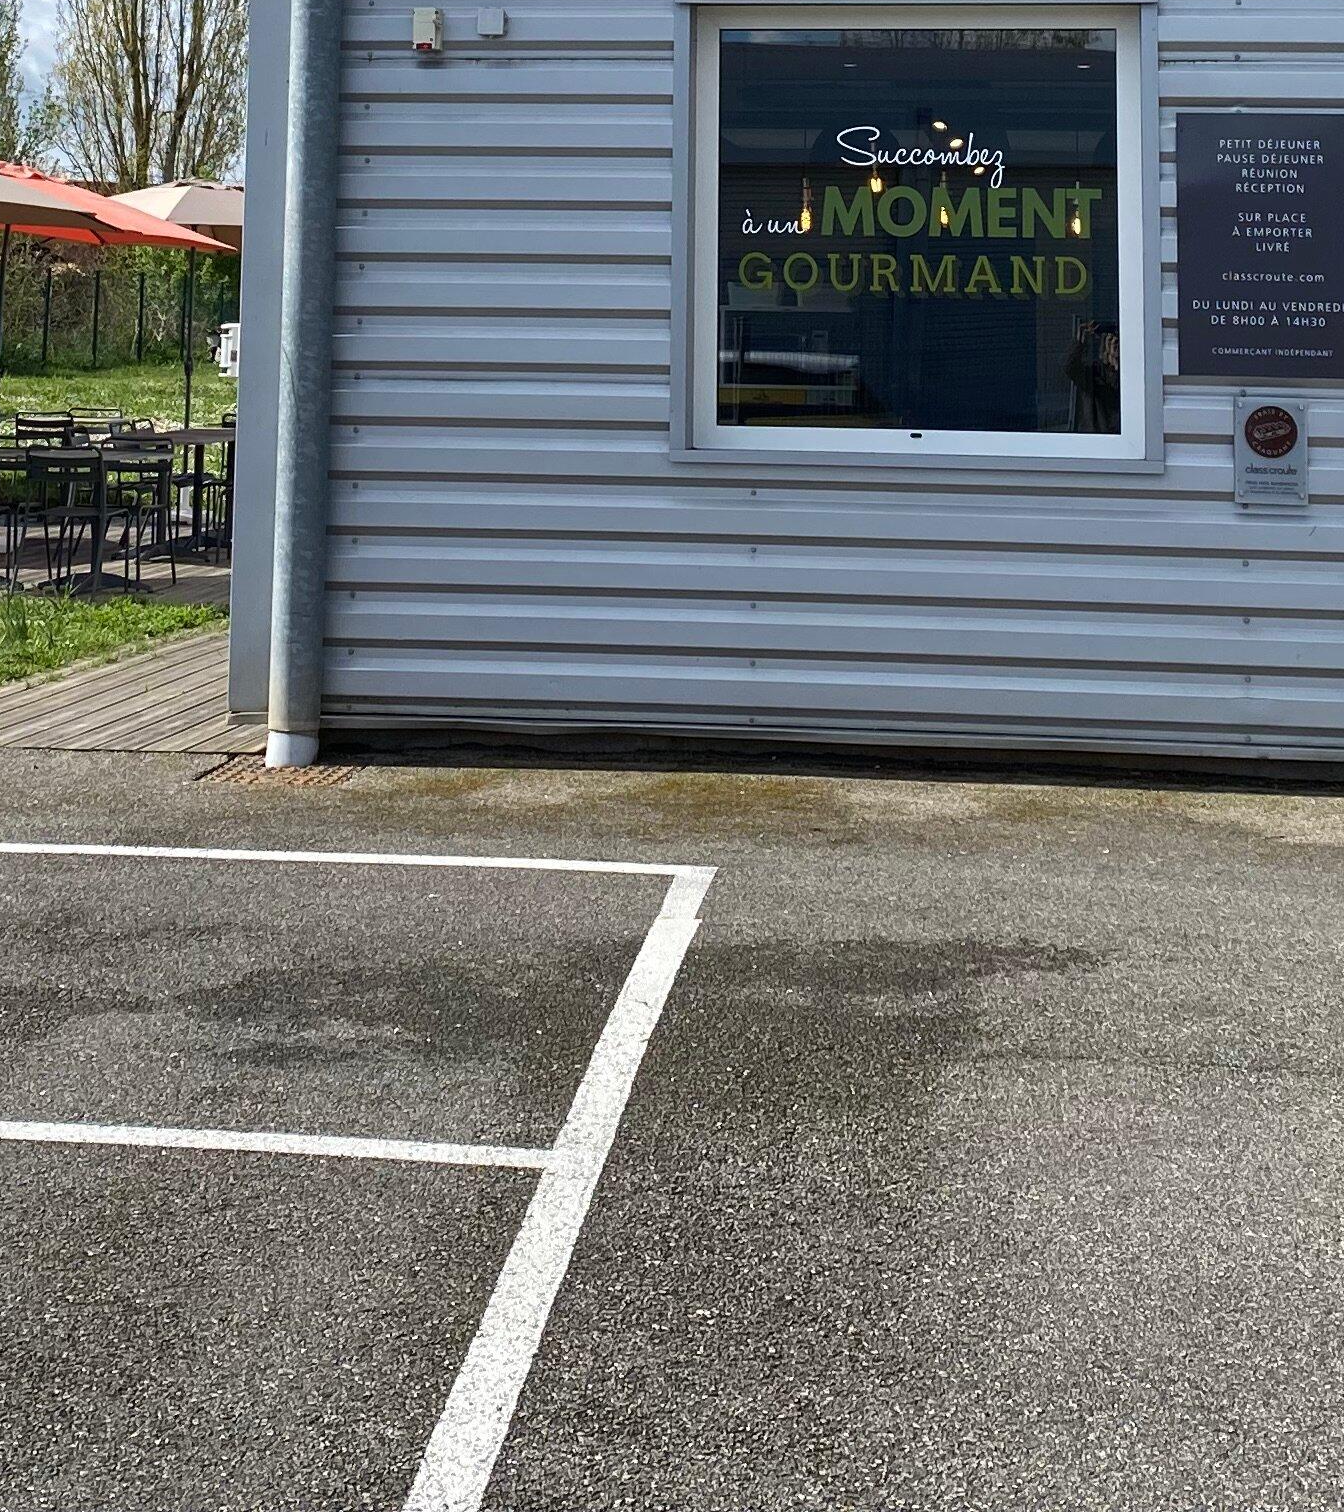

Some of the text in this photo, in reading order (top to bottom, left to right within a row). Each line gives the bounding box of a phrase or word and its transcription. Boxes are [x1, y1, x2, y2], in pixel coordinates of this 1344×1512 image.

[1219, 138, 1321, 151] PETIT DÉJEUNER
[836, 125, 1006, 189] Succombez
[1216, 152, 1324, 165] PAUSE DÉJEUNER
[1241, 166, 1298, 179] RÉUNION
[1235, 180, 1305, 194] RÉCEPTION
[742, 185, 1103, 240] à un MOMENT
[1238, 212, 1307, 223] SUR PLACE
[1232, 225, 1313, 238] À EMPORTER
[1255, 241, 1290, 253] LIVRÉ
[737, 251, 1091, 296] GOURMAND
[1222, 271, 1325, 283] classcroute.com
[1192, 300, 1210, 311] DU
[1215, 300, 1254, 311] LUNDI
[1259, 301, 1277, 312] AU
[1210, 314, 1326, 327] DE 8H00 À 14H30
[1211, 347, 1334, 357] COMMERÇANT INDÉPENDANT
